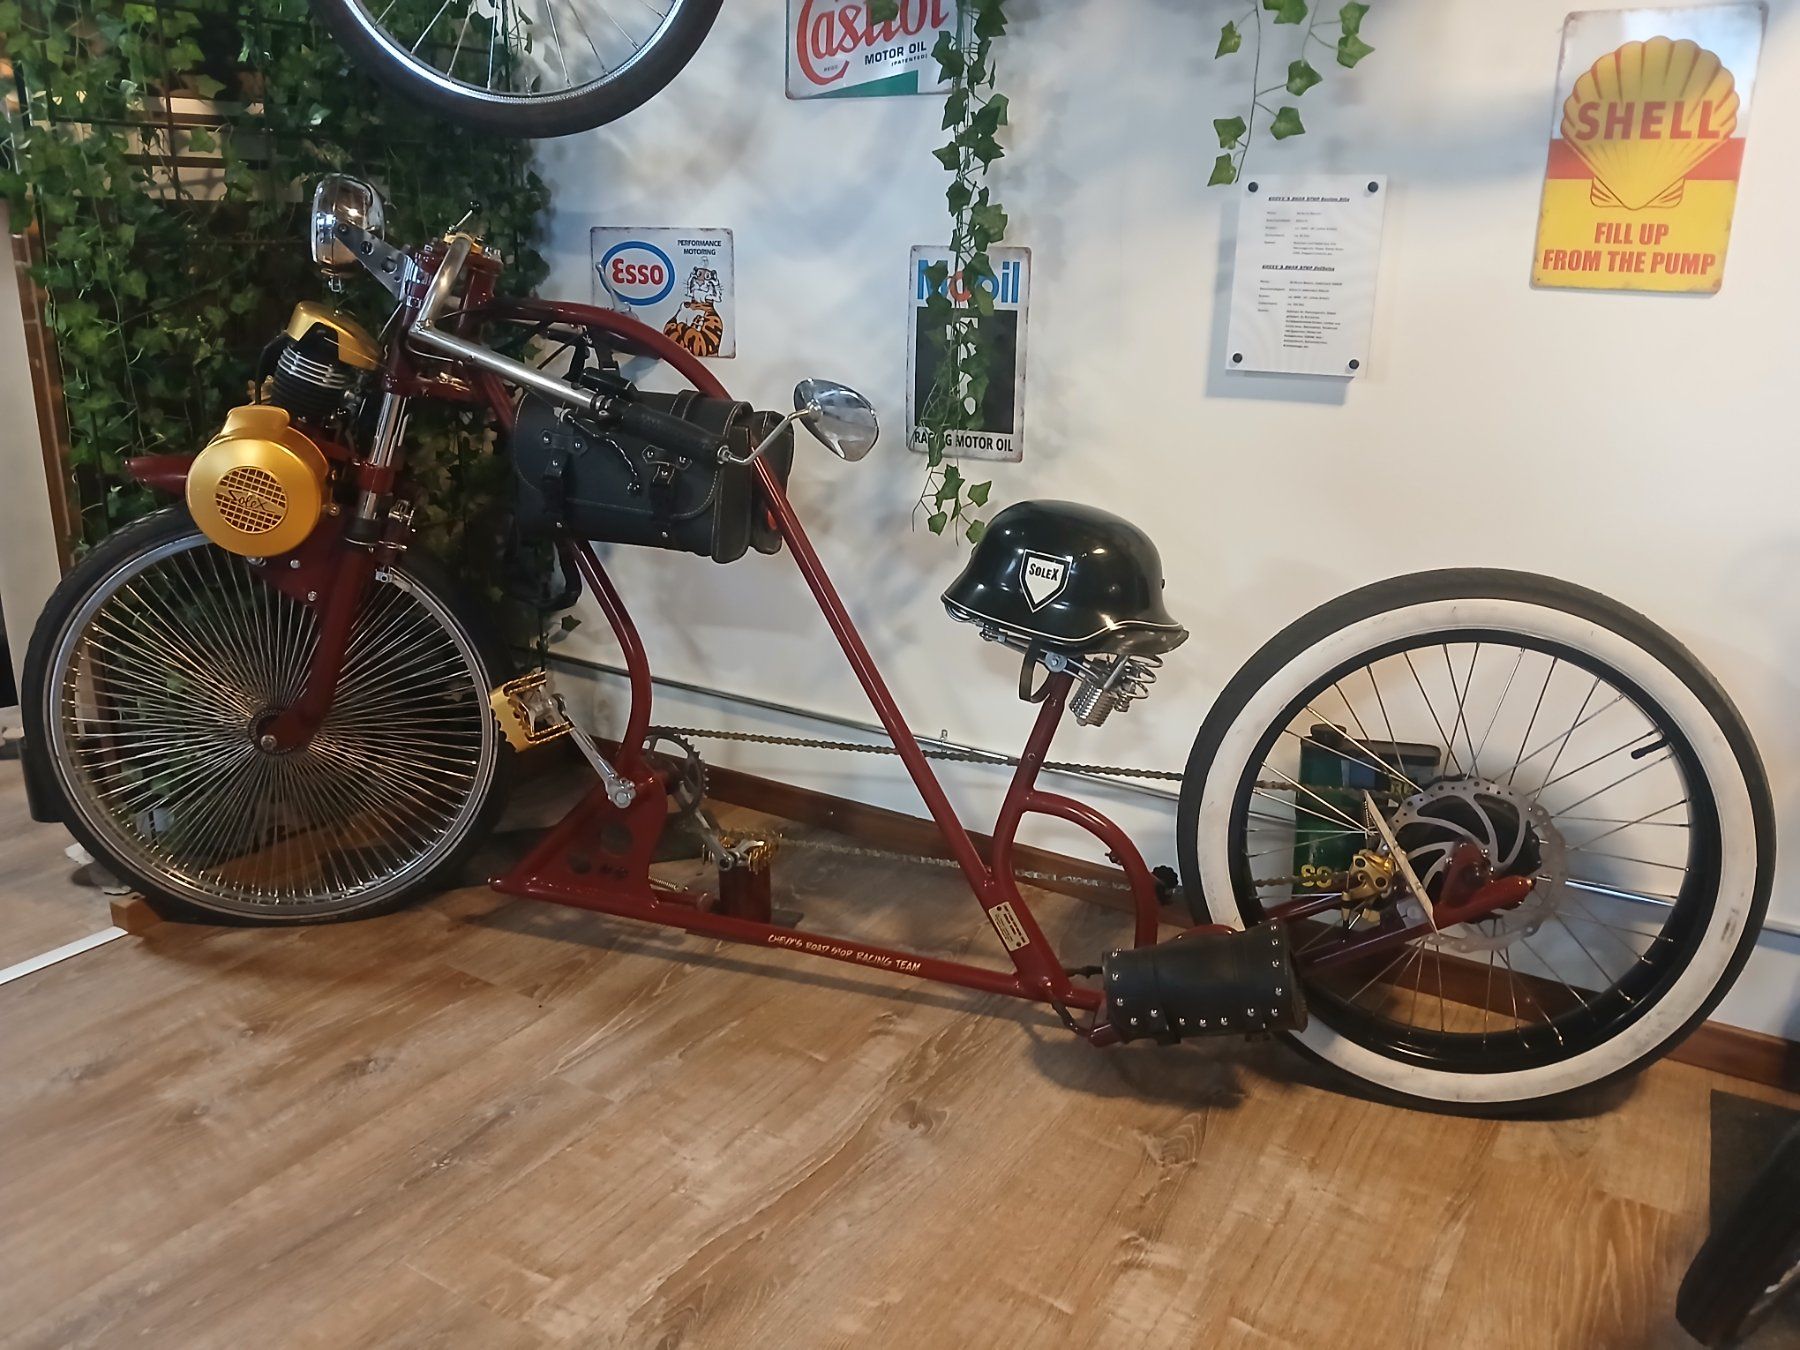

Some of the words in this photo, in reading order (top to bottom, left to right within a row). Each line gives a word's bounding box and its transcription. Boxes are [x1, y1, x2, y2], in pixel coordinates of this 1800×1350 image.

[865, 47, 904, 65] MOTOR
[908, 41, 927, 54] OIL
[1575, 100, 1721, 141] SHELL
[677, 239, 722, 247] PERFORMANCE
[1594, 222, 1634, 245] FILL
[1639, 223, 1670, 245] UP
[683, 248, 716, 256] MOTORING
[1542, 249, 1602, 271] FROM
[1607, 250, 1647, 272] THE
[1650, 252, 1716, 275] PUMP
[914, 431, 952, 447] RAG
[956, 434, 993, 451] MOTOR
[996, 439, 1013, 452] OIL
[805, 942, 830, 952] ROAD
[831, 946, 853, 958] STOP
[856, 951, 893, 966] RACING
[895, 959, 922, 972] TEAM
